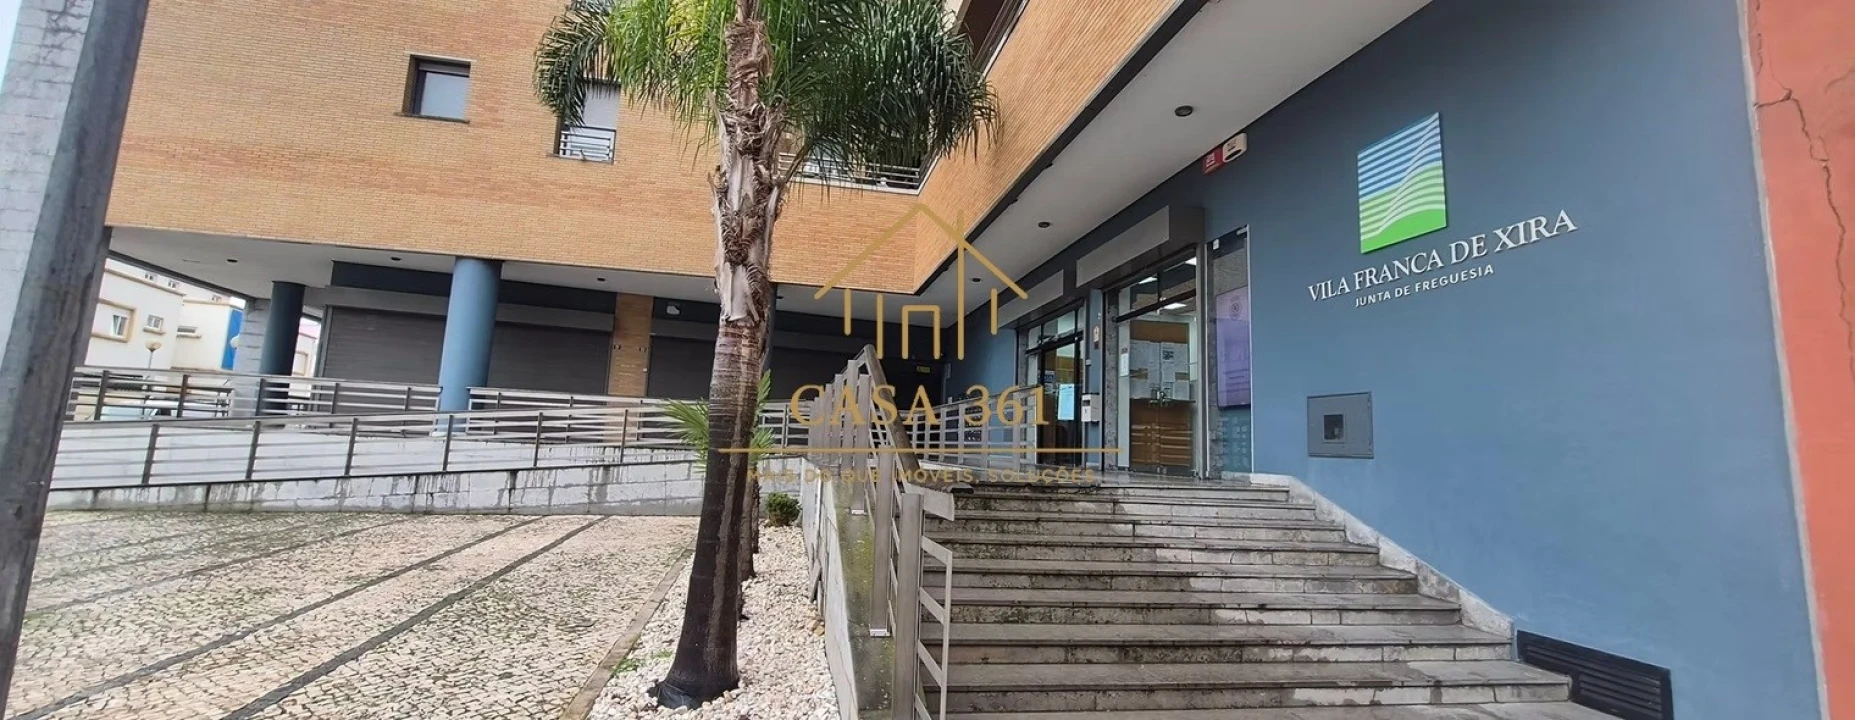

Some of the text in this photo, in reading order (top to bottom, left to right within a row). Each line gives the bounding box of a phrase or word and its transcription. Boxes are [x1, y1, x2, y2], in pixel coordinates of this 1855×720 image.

[1308, 209, 1578, 302] VILA FRANCA DE XIRA
[1355, 264, 1494, 308] JUNTA DE FREGUESIA
